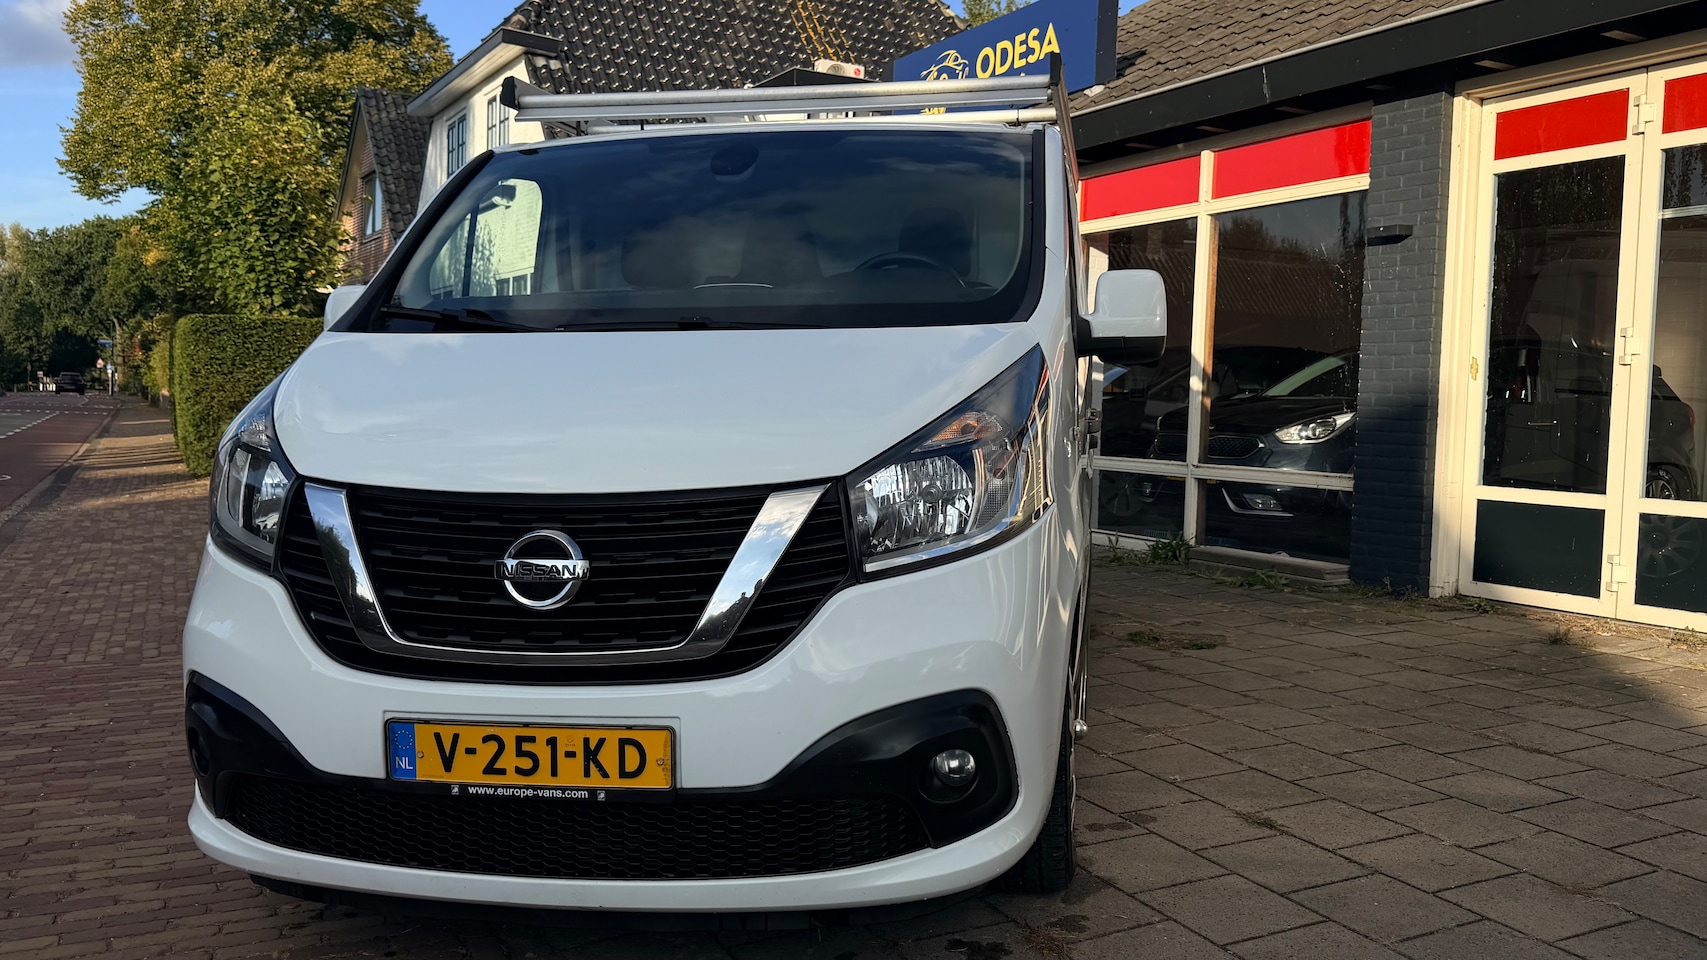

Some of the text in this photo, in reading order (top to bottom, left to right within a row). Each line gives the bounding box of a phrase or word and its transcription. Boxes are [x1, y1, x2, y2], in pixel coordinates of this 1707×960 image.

[976, 22, 1060, 79] ODESA
[500, 563, 577, 577] NISSAN
[433, 732, 647, 779] V-251-KD
[395, 756, 413, 770] NL
[468, 786, 589, 799] www.europe-vans.com
